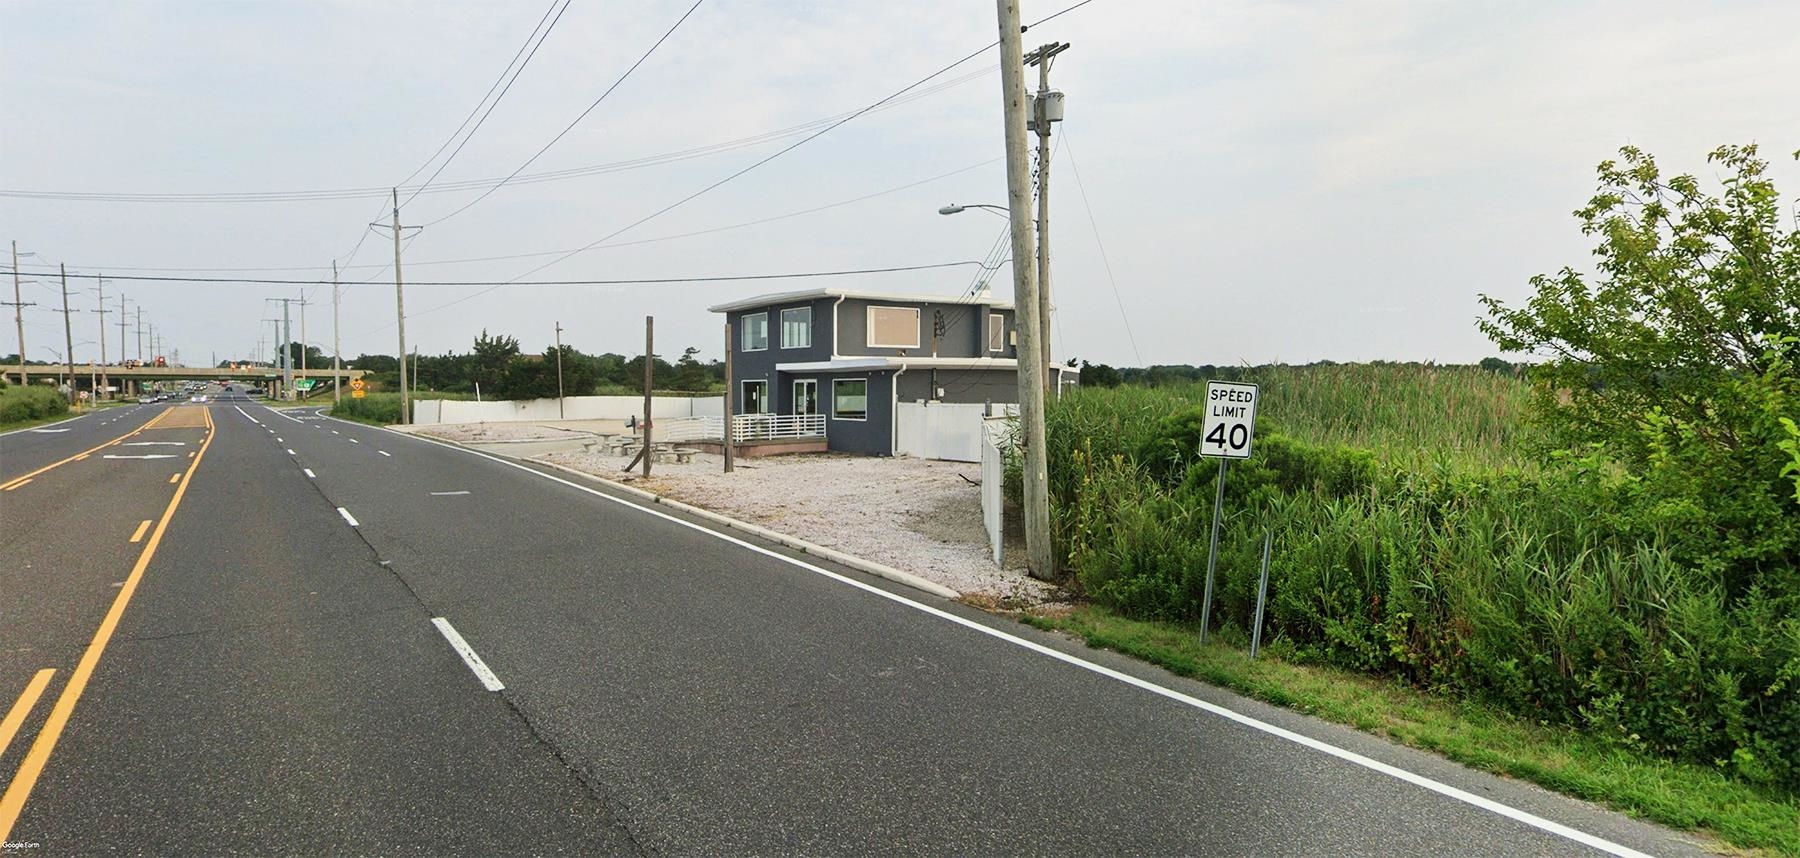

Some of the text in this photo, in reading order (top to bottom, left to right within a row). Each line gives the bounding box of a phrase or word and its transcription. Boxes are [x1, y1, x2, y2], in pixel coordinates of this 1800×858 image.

[1210, 389, 1253, 402] SPEED
[1213, 405, 1246, 418] LIMIT
[1205, 422, 1248, 450] 40
